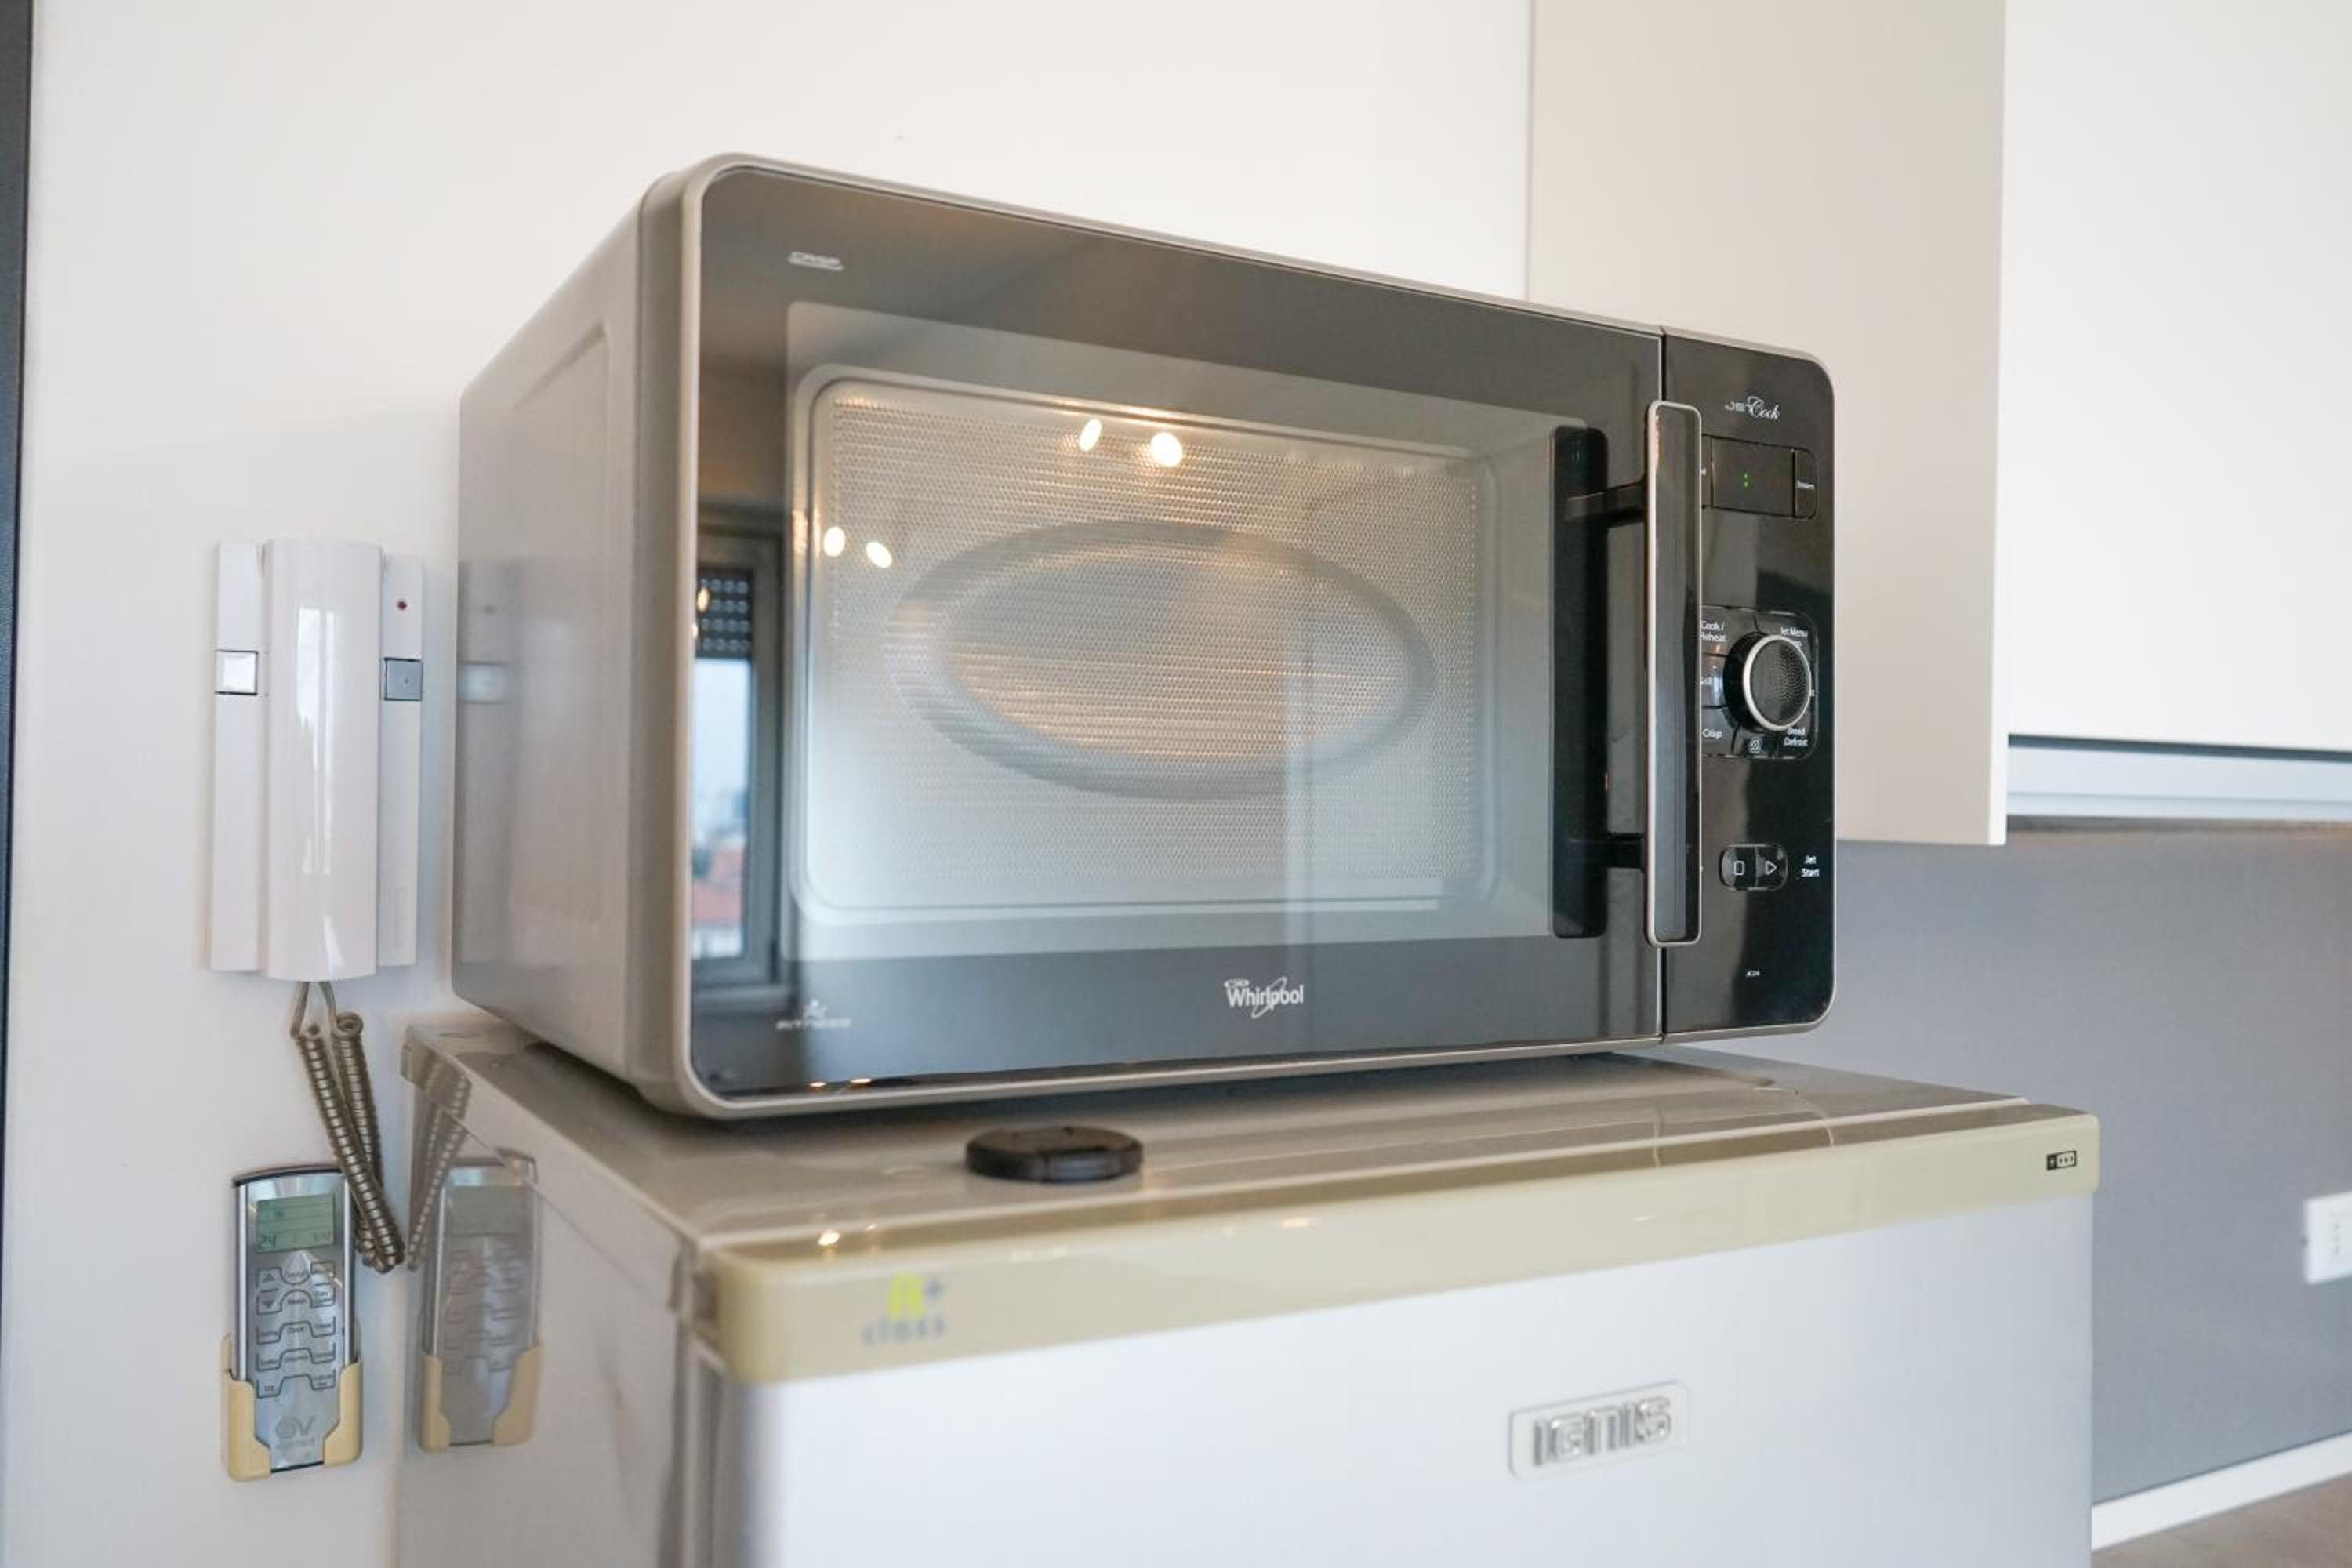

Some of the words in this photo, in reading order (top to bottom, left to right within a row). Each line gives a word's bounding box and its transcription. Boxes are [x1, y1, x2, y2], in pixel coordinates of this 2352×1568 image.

[1748, 396, 1780, 419] Cook
[1801, 868, 1820, 877] Start
[1225, 982, 1305, 1011] Whirlpool
[1533, 1396, 1671, 1466] IGNIS
